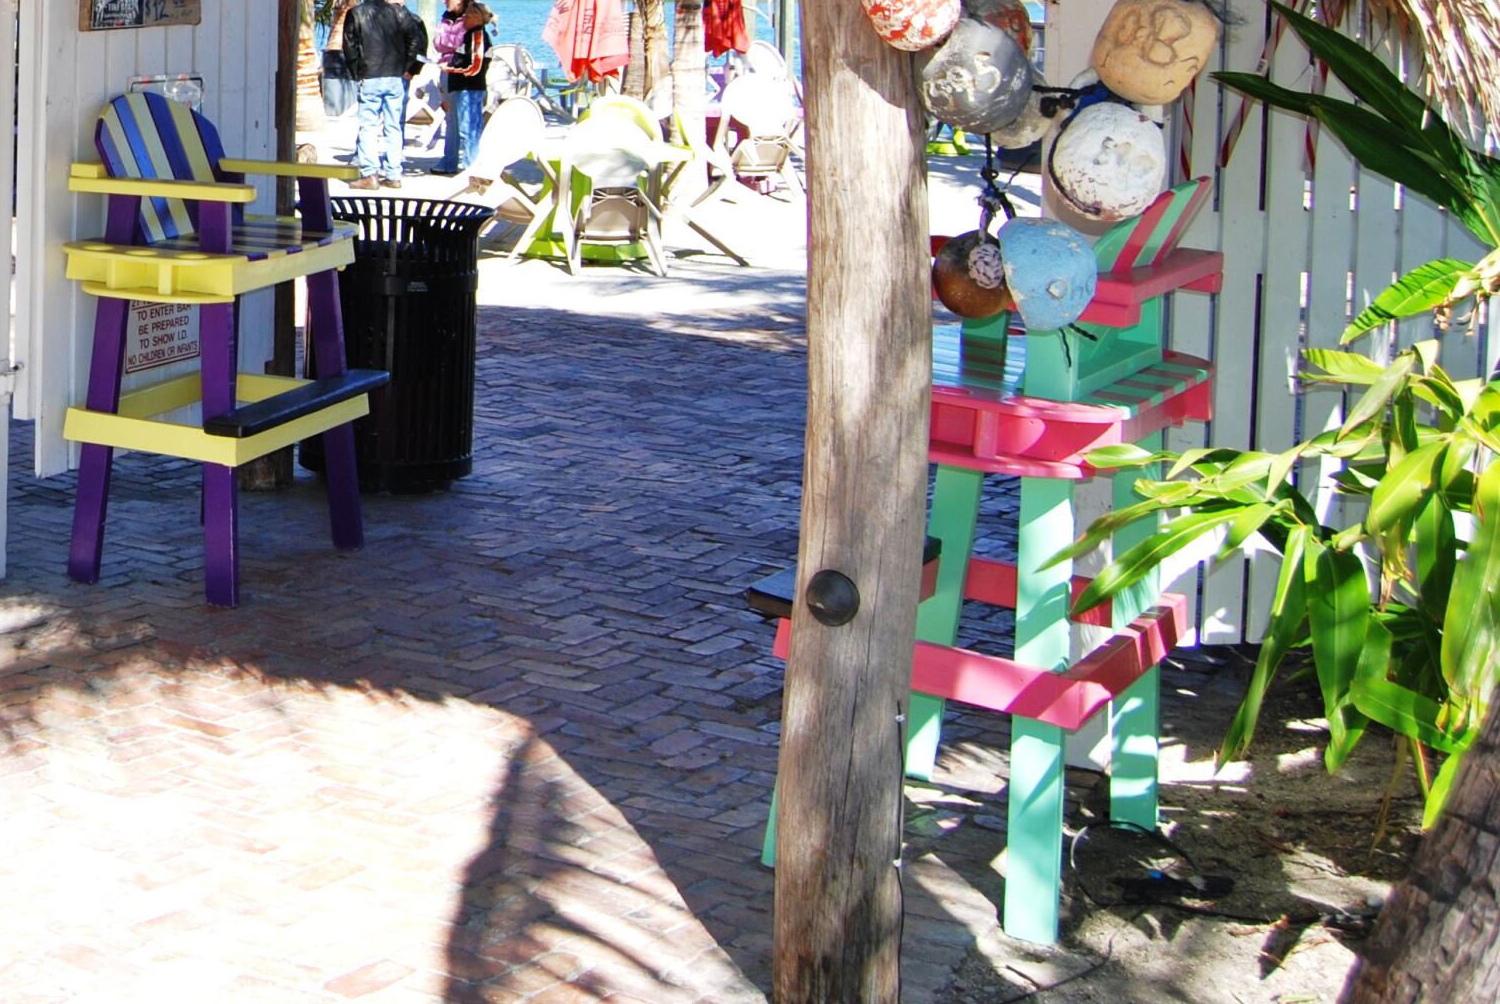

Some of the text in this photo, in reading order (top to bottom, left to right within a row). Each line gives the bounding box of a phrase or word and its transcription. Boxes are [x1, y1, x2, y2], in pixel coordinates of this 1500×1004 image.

[138, 310, 147, 321] TO
[150, 305, 174, 318] ENTER
[138, 315, 189, 335] BE PREPARED
[140, 338, 149, 349] TO
[152, 333, 175, 346] SHOW
[127, 354, 137, 365] NO
